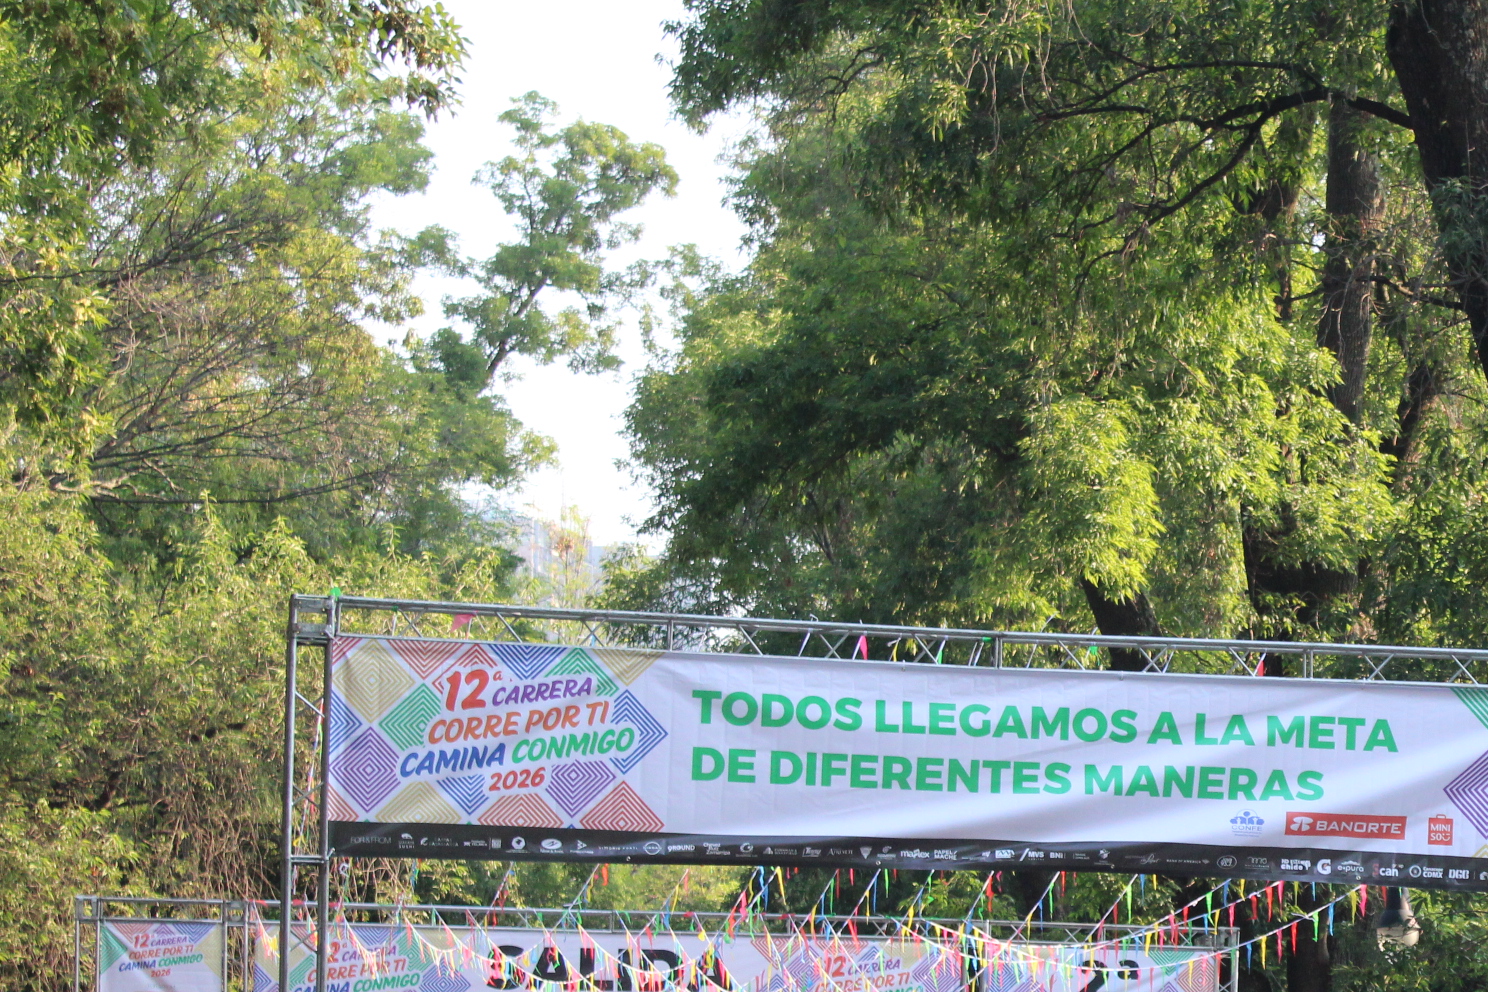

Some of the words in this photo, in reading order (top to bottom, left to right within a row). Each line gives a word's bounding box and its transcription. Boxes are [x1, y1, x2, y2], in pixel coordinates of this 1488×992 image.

[491, 677, 593, 706] CARRERA
[428, 711, 519, 744] CORRE
[525, 705, 580, 734] POR
[586, 700, 610, 725] TI
[692, 689, 862, 731] TODOS
[876, 699, 1138, 744] LLEGAMOS
[1147, 709, 1184, 746] A
[1196, 712, 1255, 747] LA
[1267, 714, 1399, 753] META
[400, 743, 505, 777] CAMINA
[511, 728, 635, 762] CONMIGO
[489, 767, 547, 792] 2026
[692, 746, 756, 785] DE
[770, 749, 1072, 795] DIFERENTES
[1084, 763, 1325, 802] MANERAS
[1231, 824, 1263, 832] CONFE
[1315, 820, 1402, 835] BANORTE
[1430, 823, 1451, 832] MINI
[1422, 871, 1443, 879] CDMX
[151, 936, 187, 947] CARRERA
[119, 960, 156, 972] CAMINA
[158, 953, 203, 967] CONMIGO
[129, 948, 161, 960] CORRE
[163, 946, 183, 957] POR
[185, 945, 194, 953] TI
[151, 968, 171, 978] 2026
[307, 964, 358, 983] CRRE
[394, 958, 407, 972] TI
[486, 944, 734, 992] SALIDA
[353, 972, 420, 992] CONMIGO
